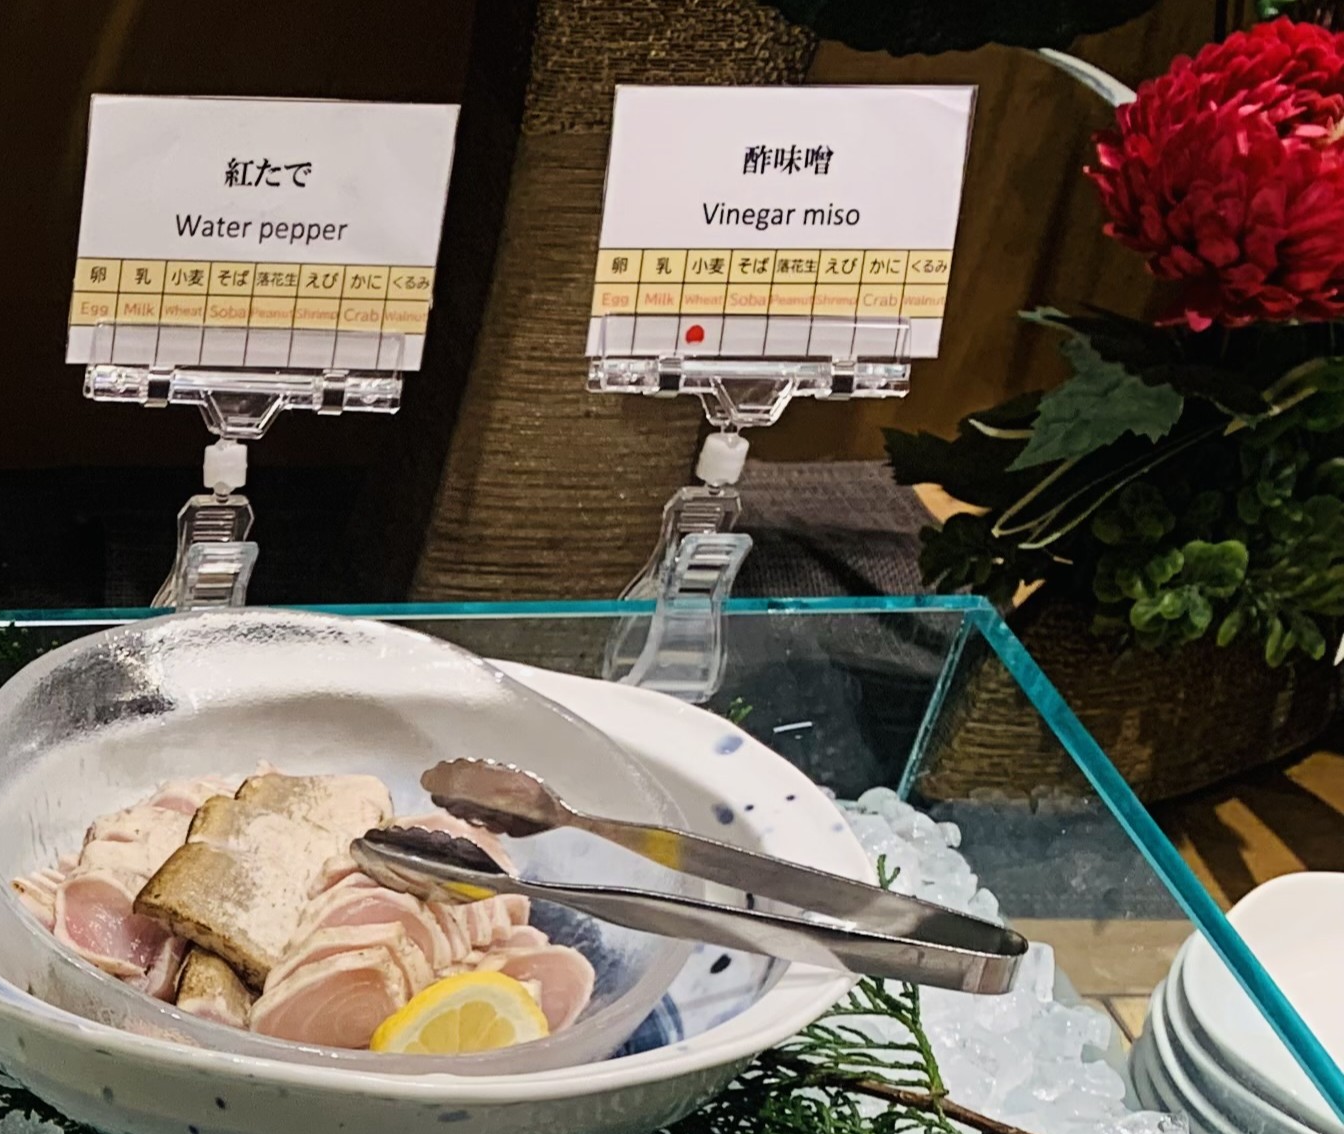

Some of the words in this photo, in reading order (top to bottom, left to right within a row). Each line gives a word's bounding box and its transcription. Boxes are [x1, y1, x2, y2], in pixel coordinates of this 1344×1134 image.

[743, 145, 833, 174] 酢味噌
[225, 158, 311, 187] 紅たで
[703, 203, 795, 230] Vinegar
[804, 204, 859, 225] miso
[177, 215, 252, 237] Water
[259, 222, 347, 245] pepper
[611, 258, 628, 274] 卵
[655, 258, 672, 274] 乳
[690, 257, 724, 274] 小麦
[736, 258, 768, 274] そば
[775, 258, 817, 274] 落花生
[823, 258, 857, 274] えび
[868, 258, 901, 274] かに
[910, 260, 949, 274] くるみ
[89, 267, 107, 283] 卵
[134, 268, 151, 284] 乳
[169, 268, 204, 286] 小麦
[215, 270, 248, 287] そば
[254, 272, 297, 287] 落花生
[303, 272, 337, 289] えび
[348, 273, 382, 290] かに
[391, 276, 430, 291] くるみ
[80, 301, 109, 318] Egg
[123, 302, 154, 316] Milk
[209, 304, 247, 319] Soba
[249, 307, 293, 321] Peanut
[344, 308, 380, 323] Crab
[603, 292, 631, 309] Egg
[645, 293, 676, 306] Milk
[730, 293, 768, 307] Soba
[863, 293, 899, 307] Crab
